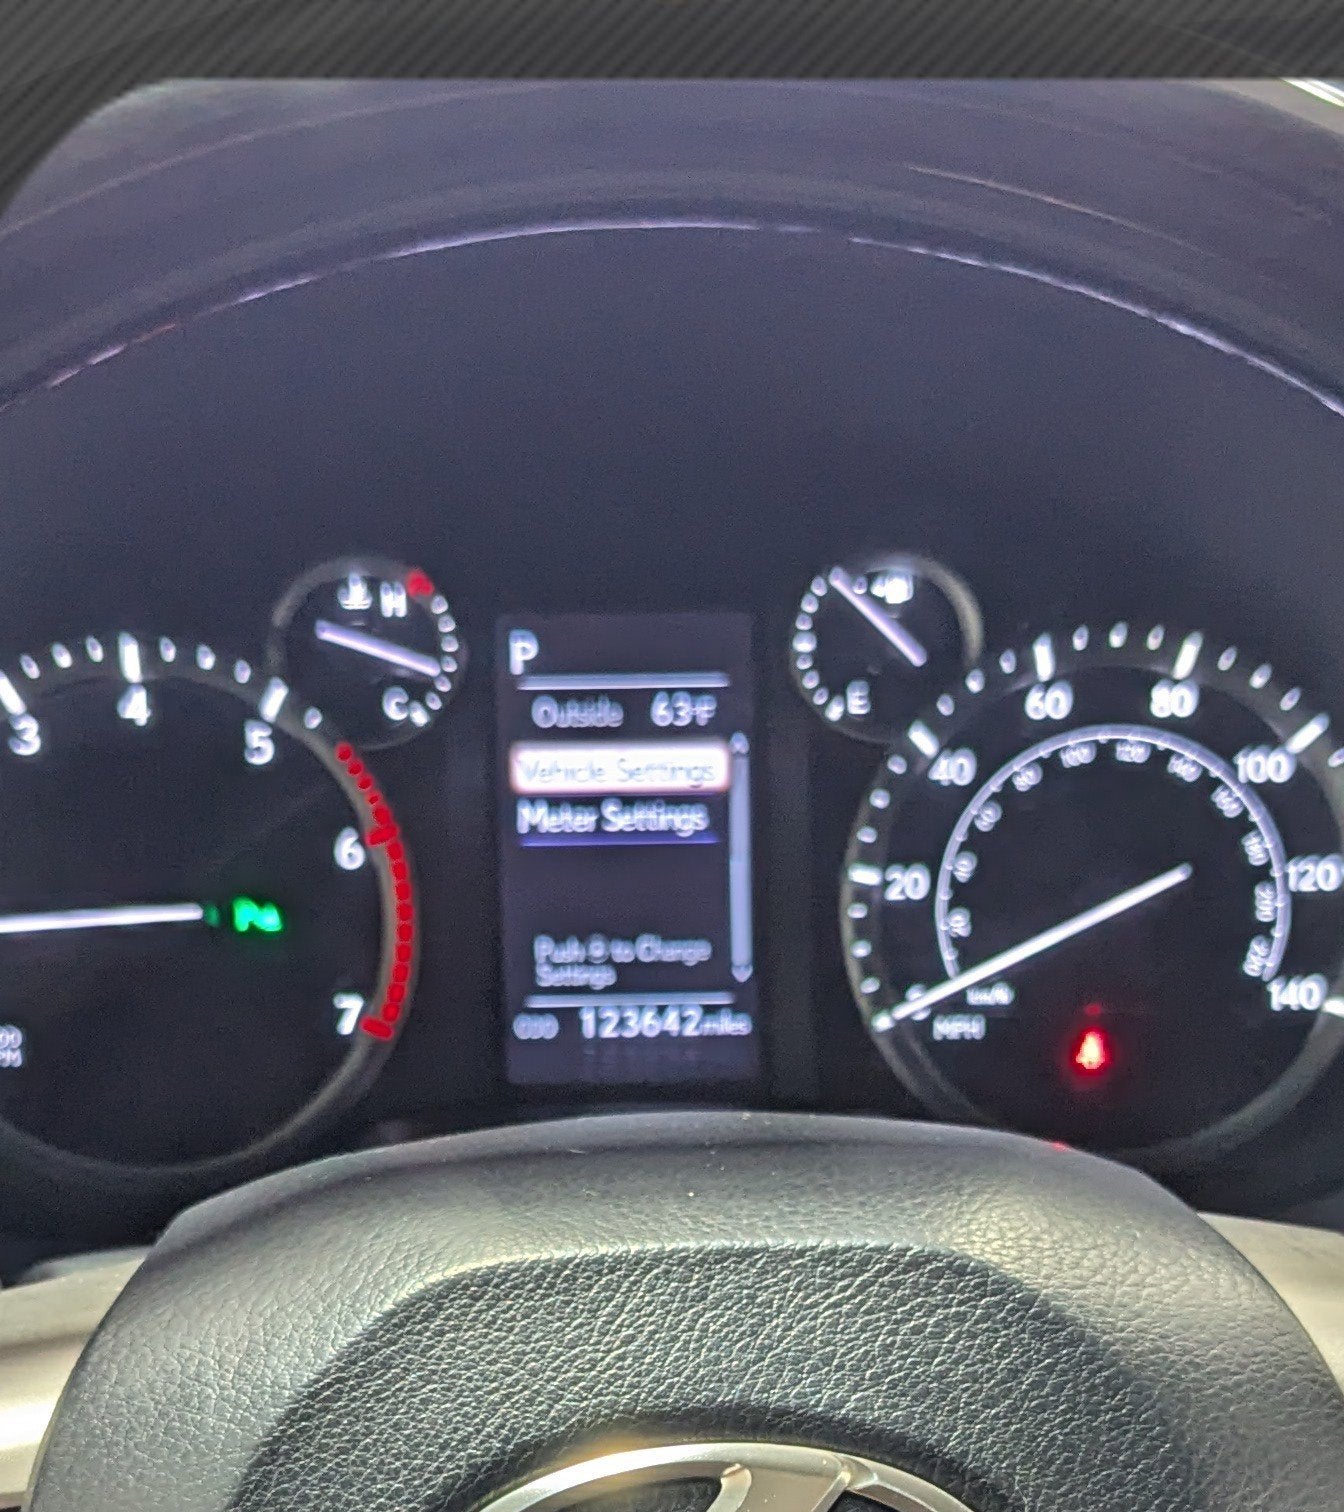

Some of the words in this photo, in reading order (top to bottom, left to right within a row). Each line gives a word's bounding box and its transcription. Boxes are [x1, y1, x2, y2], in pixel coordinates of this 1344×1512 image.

[508, 629, 540, 675] P
[117, 683, 151, 726] 4
[382, 686, 410, 721] C
[531, 695, 624, 729] Outside
[846, 679, 871, 715] E
[1025, 678, 1074, 720] 60
[1150, 678, 1199, 720] 80
[8, 714, 42, 756] 3
[243, 719, 276, 765] 5
[519, 760, 605, 783] Vehicle
[617, 758, 716, 788] Settings
[928, 747, 978, 787] 40
[1235, 745, 1297, 784] 100
[516, 799, 597, 834] Meter
[600, 798, 709, 838] Settings
[333, 827, 365, 869] 6
[884, 863, 932, 902] 20
[1285, 855, 1343, 895] 120
[332, 991, 365, 1035] 7
[1268, 976, 1327, 1013] 140
[580, 1006, 703, 1039] 123642
[933, 1013, 986, 1041] MPH
